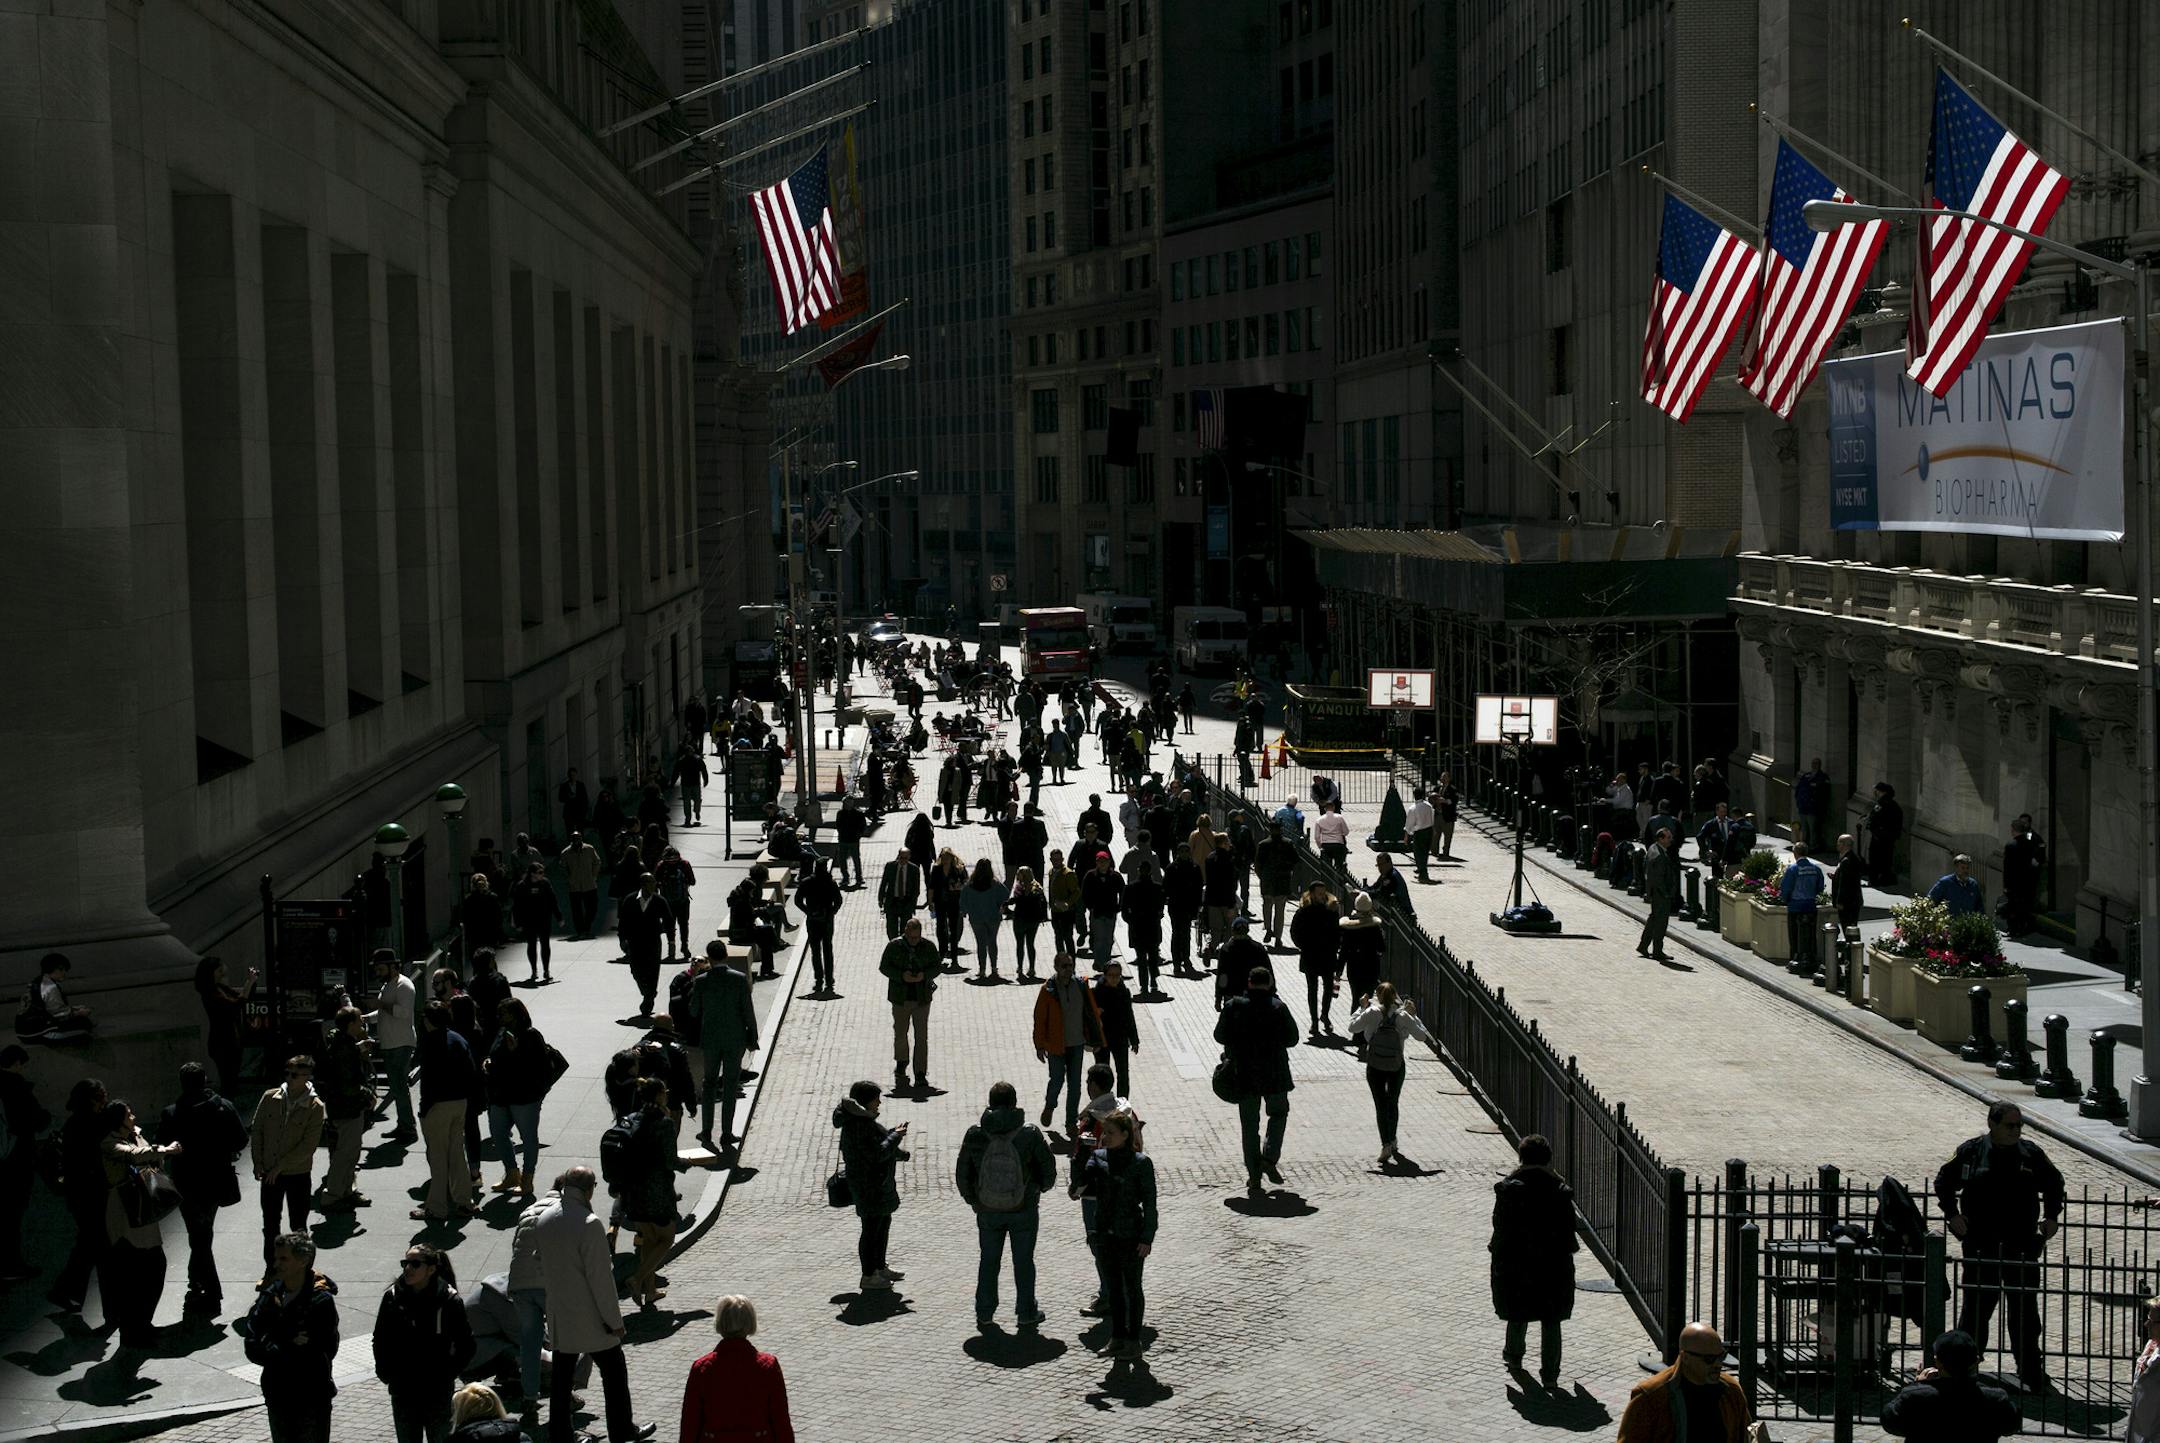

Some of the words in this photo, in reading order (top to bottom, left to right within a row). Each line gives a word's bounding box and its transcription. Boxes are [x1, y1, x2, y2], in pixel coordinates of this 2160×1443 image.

[1832, 378, 1866, 416] MTNB
[1835, 439, 1866, 464] LISTED
[1835, 487, 1852, 506] NYSE
[1853, 487, 1867, 506] MKT
[1935, 478, 2039, 518] BIOPHARMA
[245, 1002, 281, 1015] Bro
